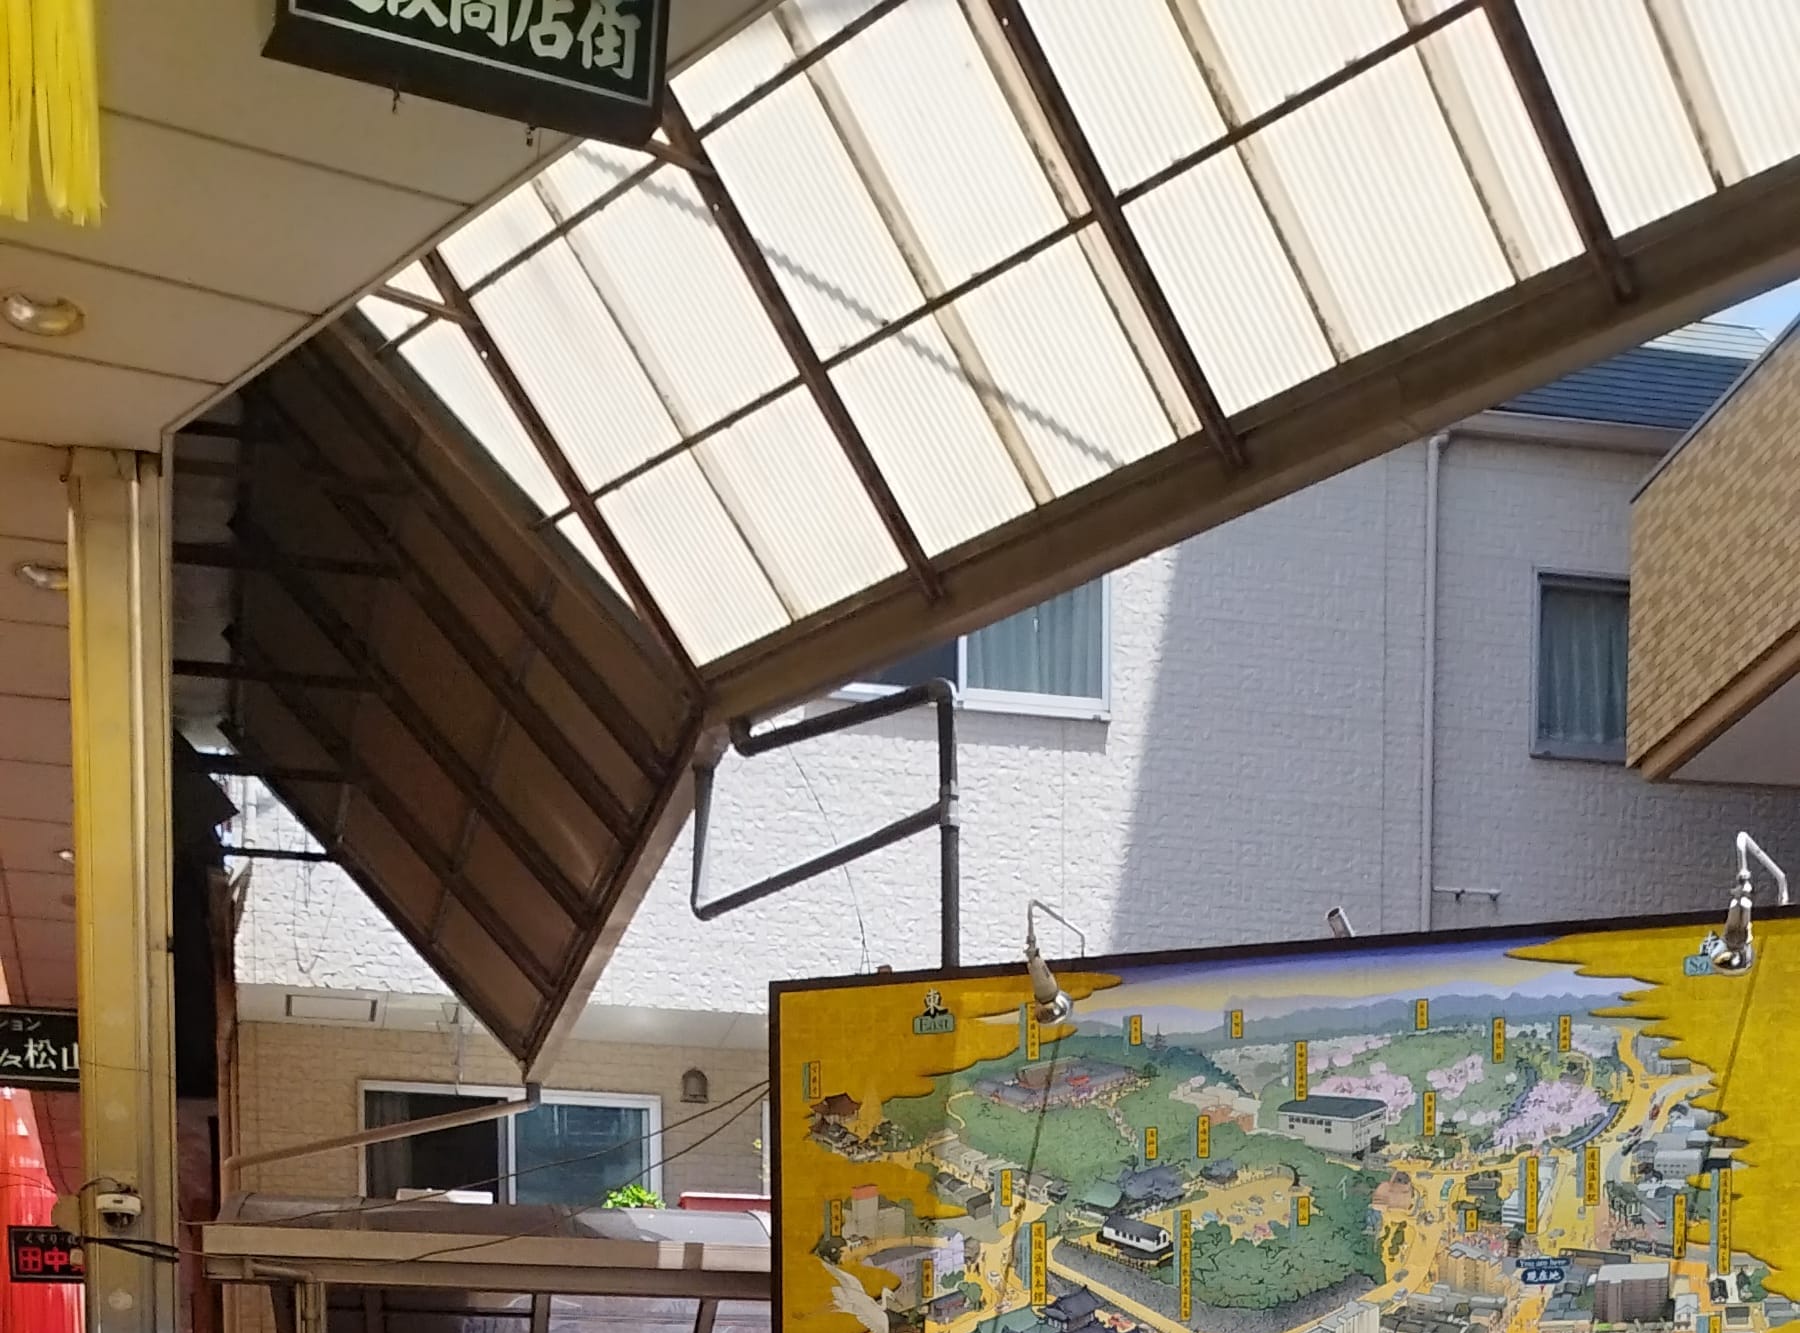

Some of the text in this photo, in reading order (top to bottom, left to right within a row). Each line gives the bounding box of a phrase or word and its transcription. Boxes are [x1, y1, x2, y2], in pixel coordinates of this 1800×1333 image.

[355, 0, 641, 79] 商店街
[924, 988, 947, 1014] 東
[919, 1018, 949, 1032] East
[18, 1247, 85, 1273] 田中
